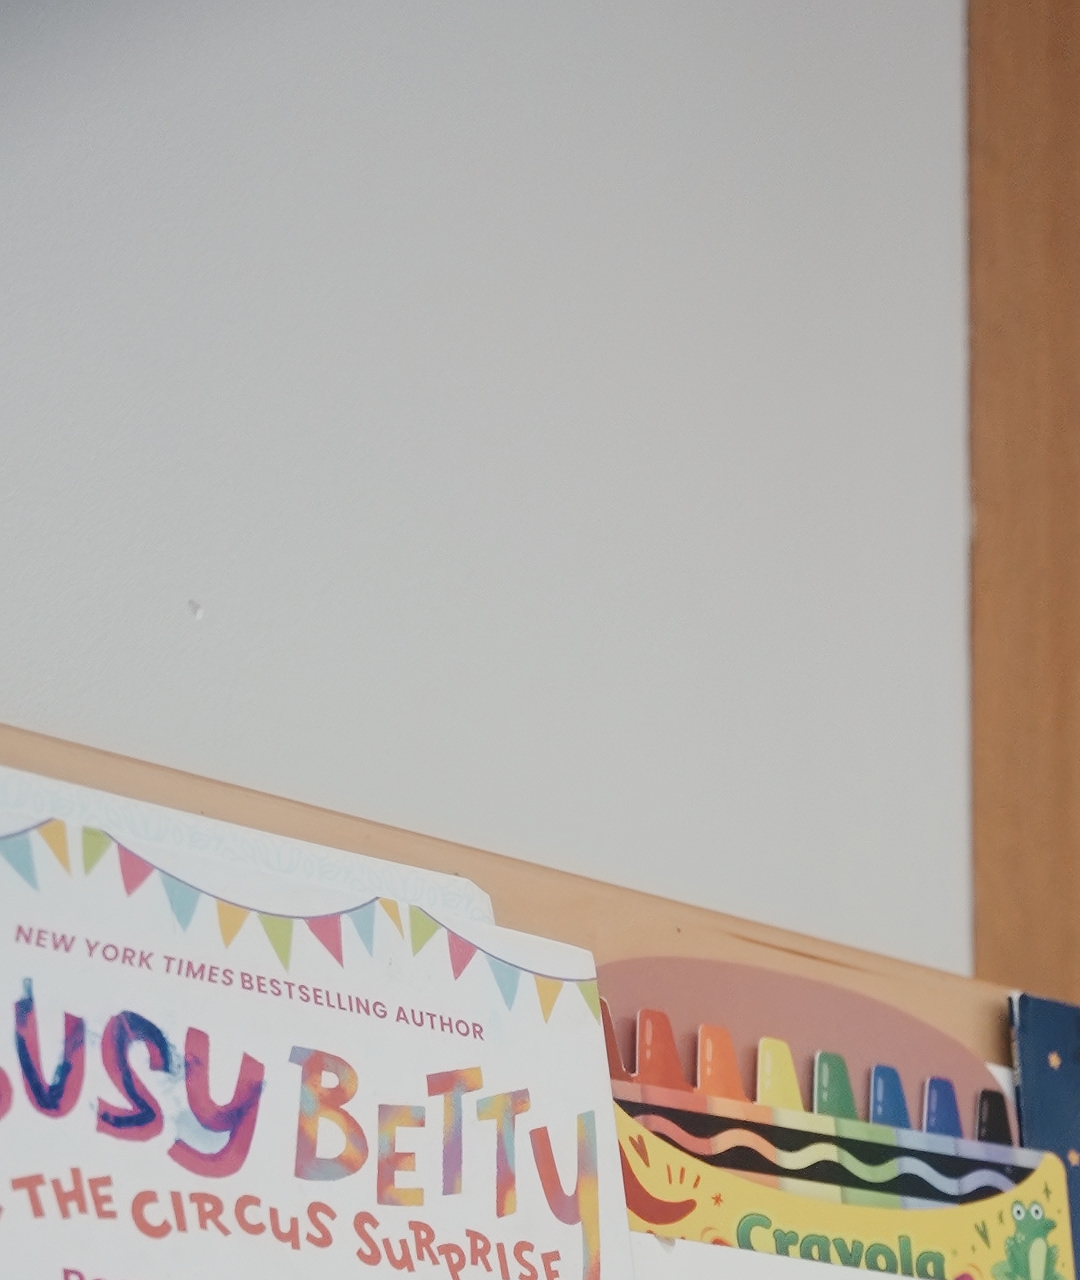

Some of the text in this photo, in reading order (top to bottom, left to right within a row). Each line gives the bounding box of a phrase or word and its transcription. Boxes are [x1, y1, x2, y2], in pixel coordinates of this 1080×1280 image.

[14, 924, 485, 1041] NEW YORK TIMES BESTSELLING AUTHOR
[11, 1166, 118, 1220] THE
